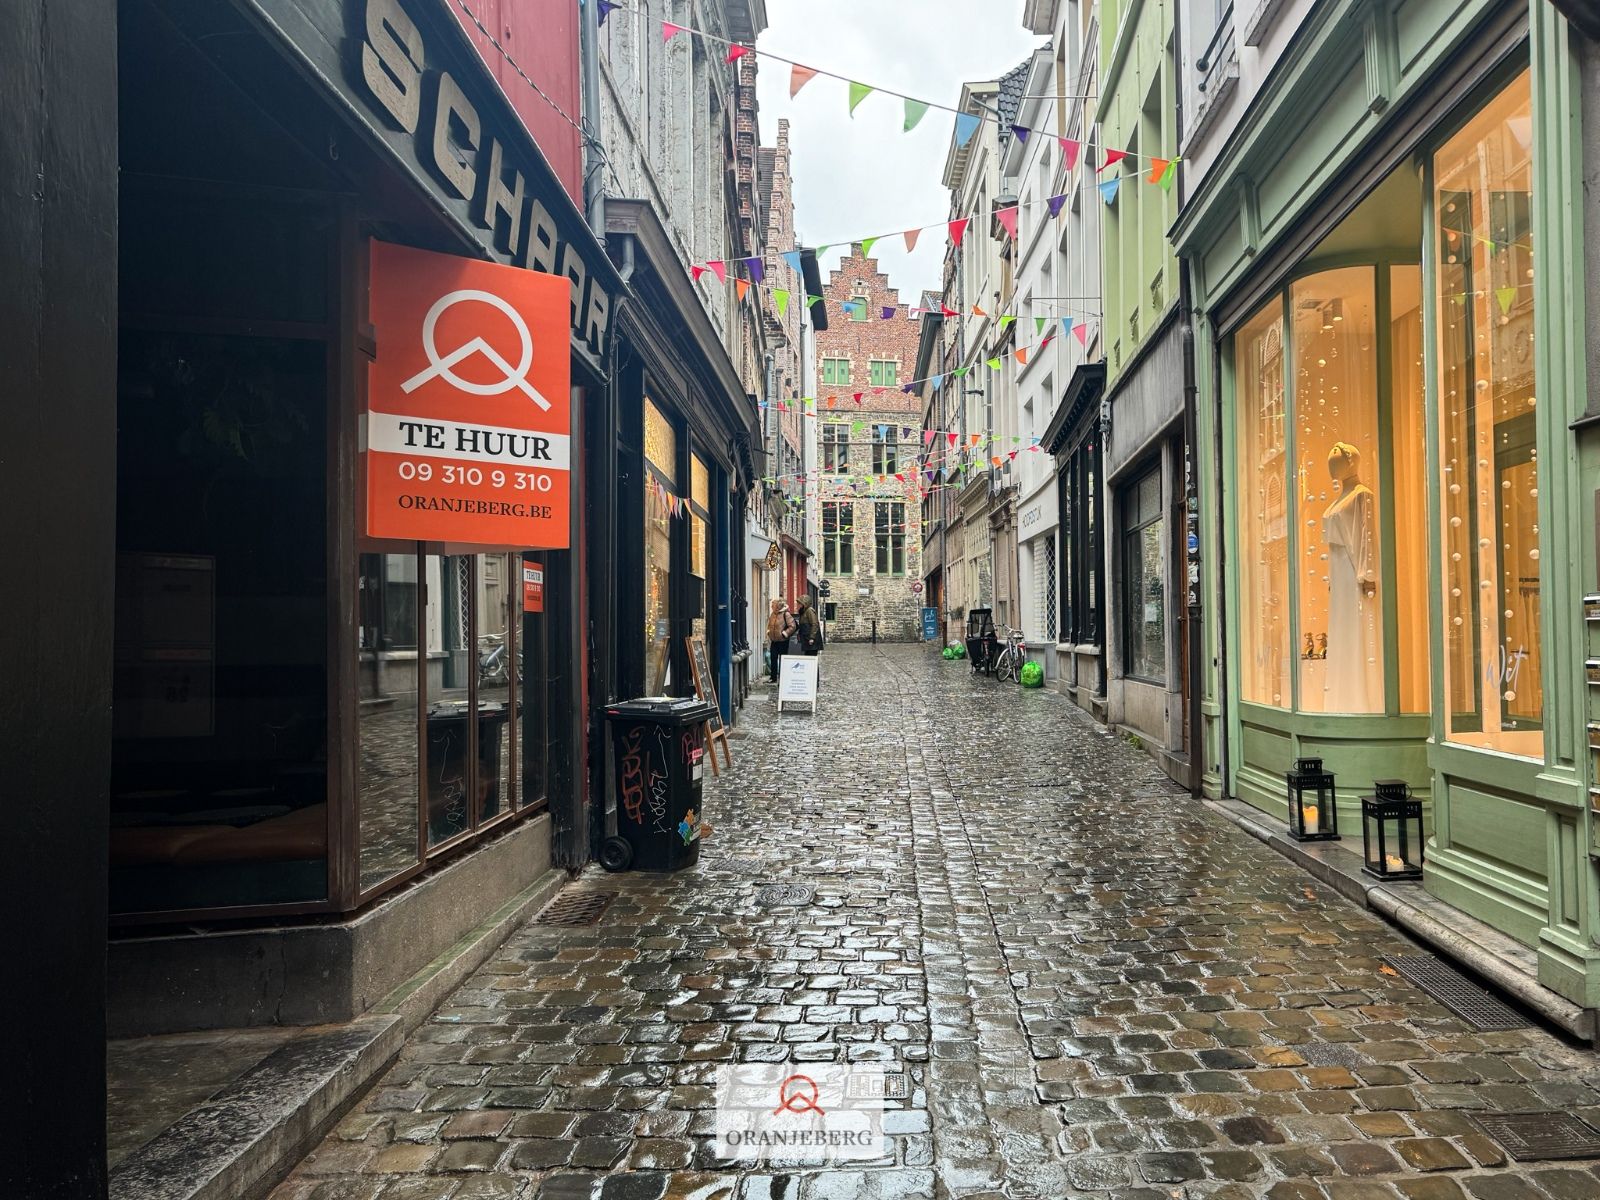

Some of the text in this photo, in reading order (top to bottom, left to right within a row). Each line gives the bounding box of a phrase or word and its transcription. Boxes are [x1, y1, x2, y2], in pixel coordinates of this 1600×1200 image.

[362, 0, 609, 356] SCHAAR
[399, 421, 552, 460] TE HUUR
[399, 461, 552, 492] 09 310 9 310
[398, 494, 552, 519] ORANJEBERG.BE
